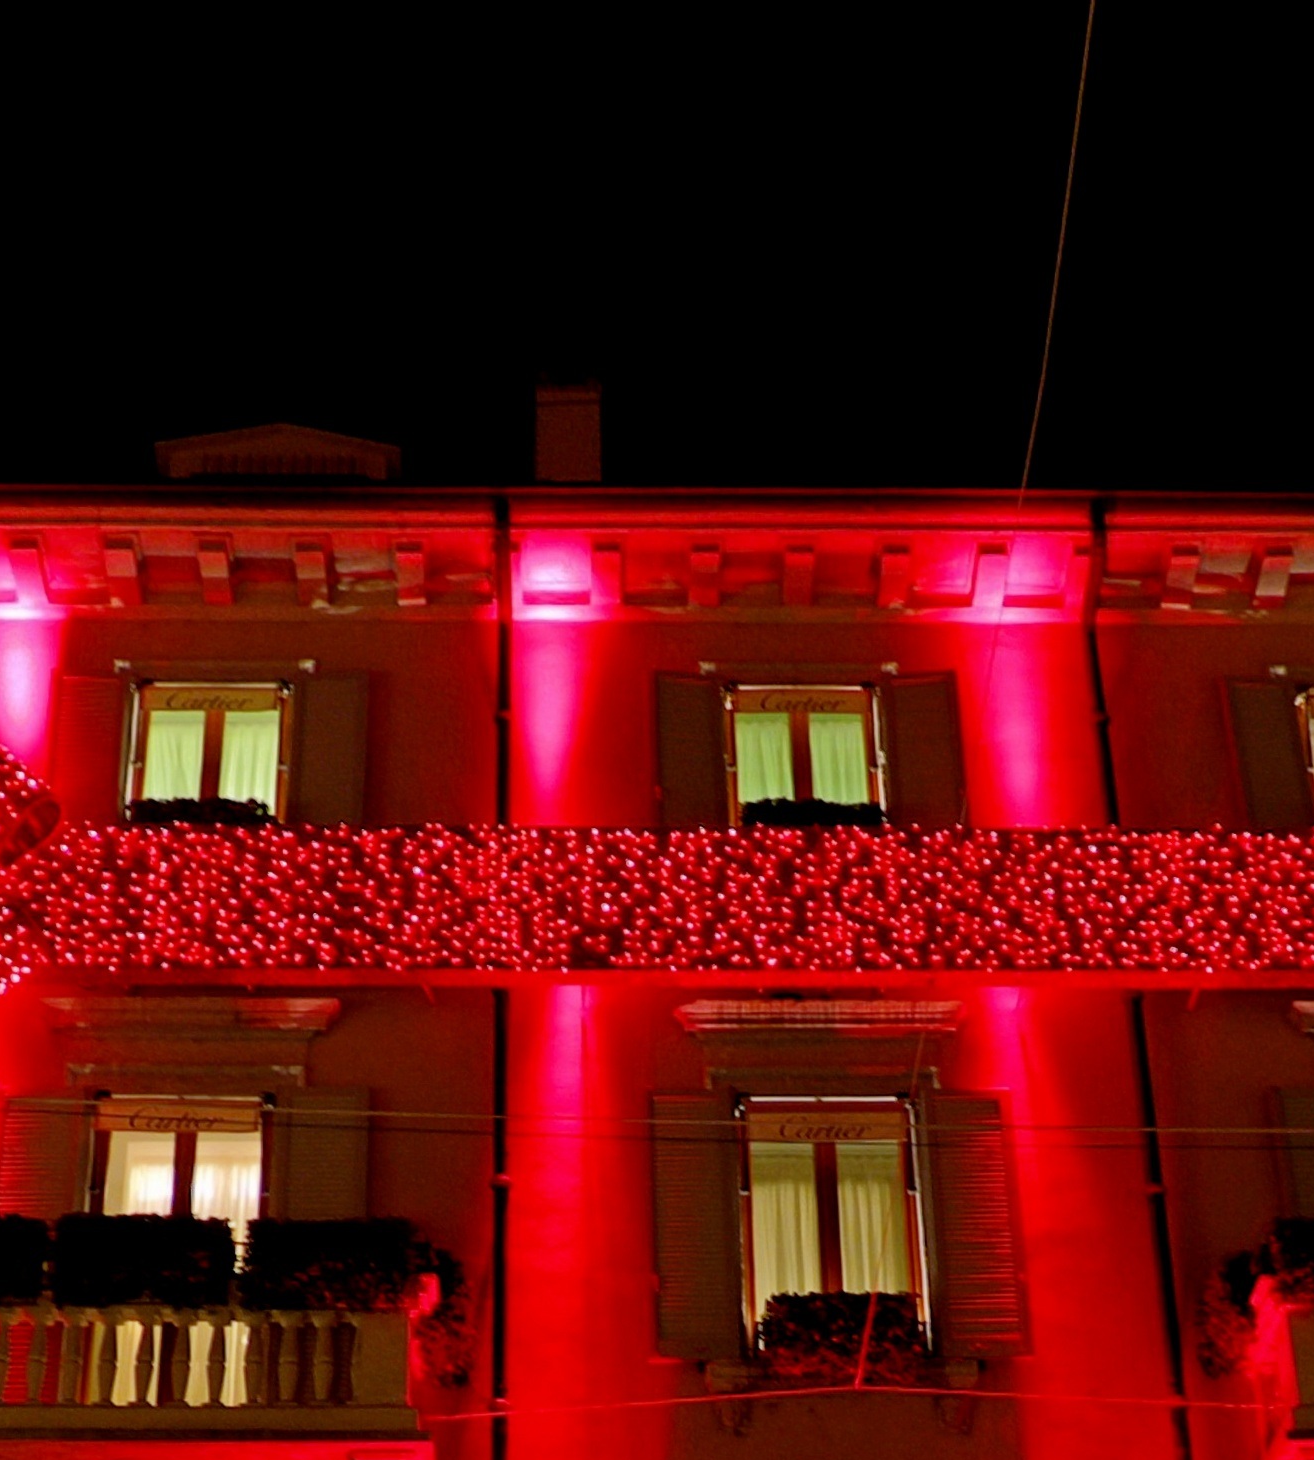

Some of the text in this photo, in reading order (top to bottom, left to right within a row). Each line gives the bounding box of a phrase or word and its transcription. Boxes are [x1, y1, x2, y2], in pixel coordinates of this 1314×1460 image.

[166, 694, 252, 710] Cartier
[759, 694, 844, 711] Cartier
[129, 1106, 223, 1129] Cartier
[778, 1115, 872, 1139] Cartier
